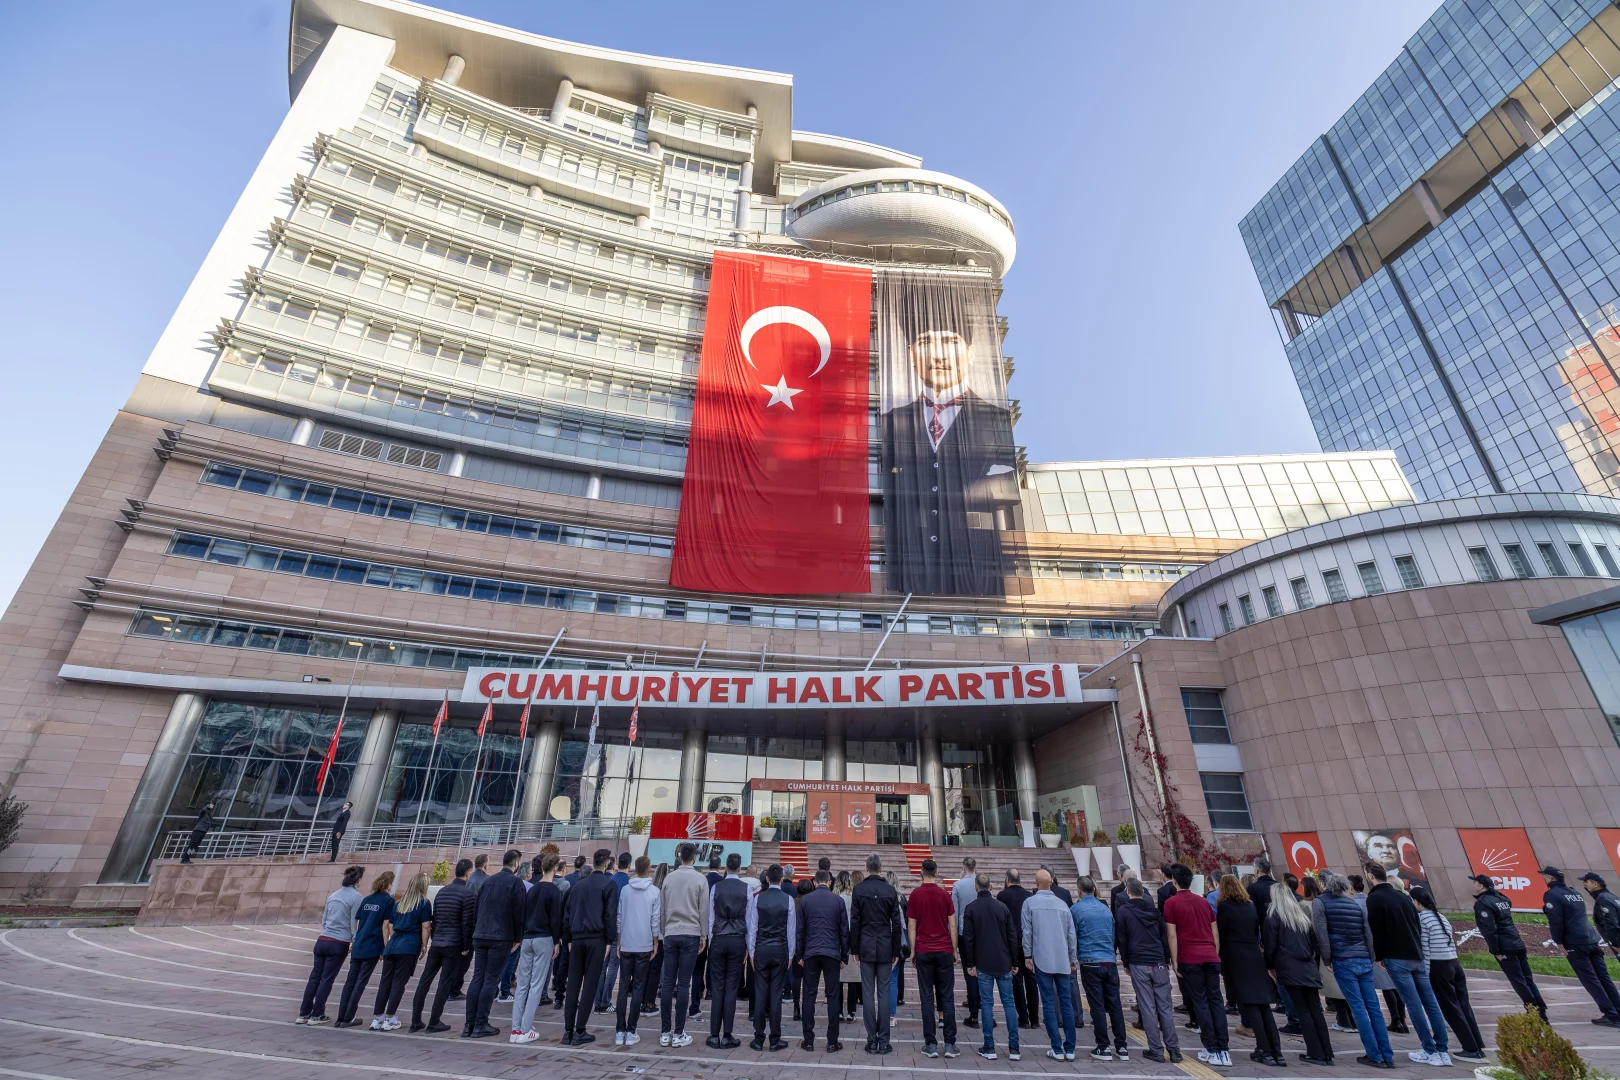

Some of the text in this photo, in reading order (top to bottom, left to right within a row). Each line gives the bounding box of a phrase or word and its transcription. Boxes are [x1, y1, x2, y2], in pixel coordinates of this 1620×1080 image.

[478, 664, 1066, 704] CUMHURİYET HALK PARTİSİ
[787, 781, 895, 793] CUMHURİYET HALK PARTİSİ
[1490, 876, 1531, 890] CHP
